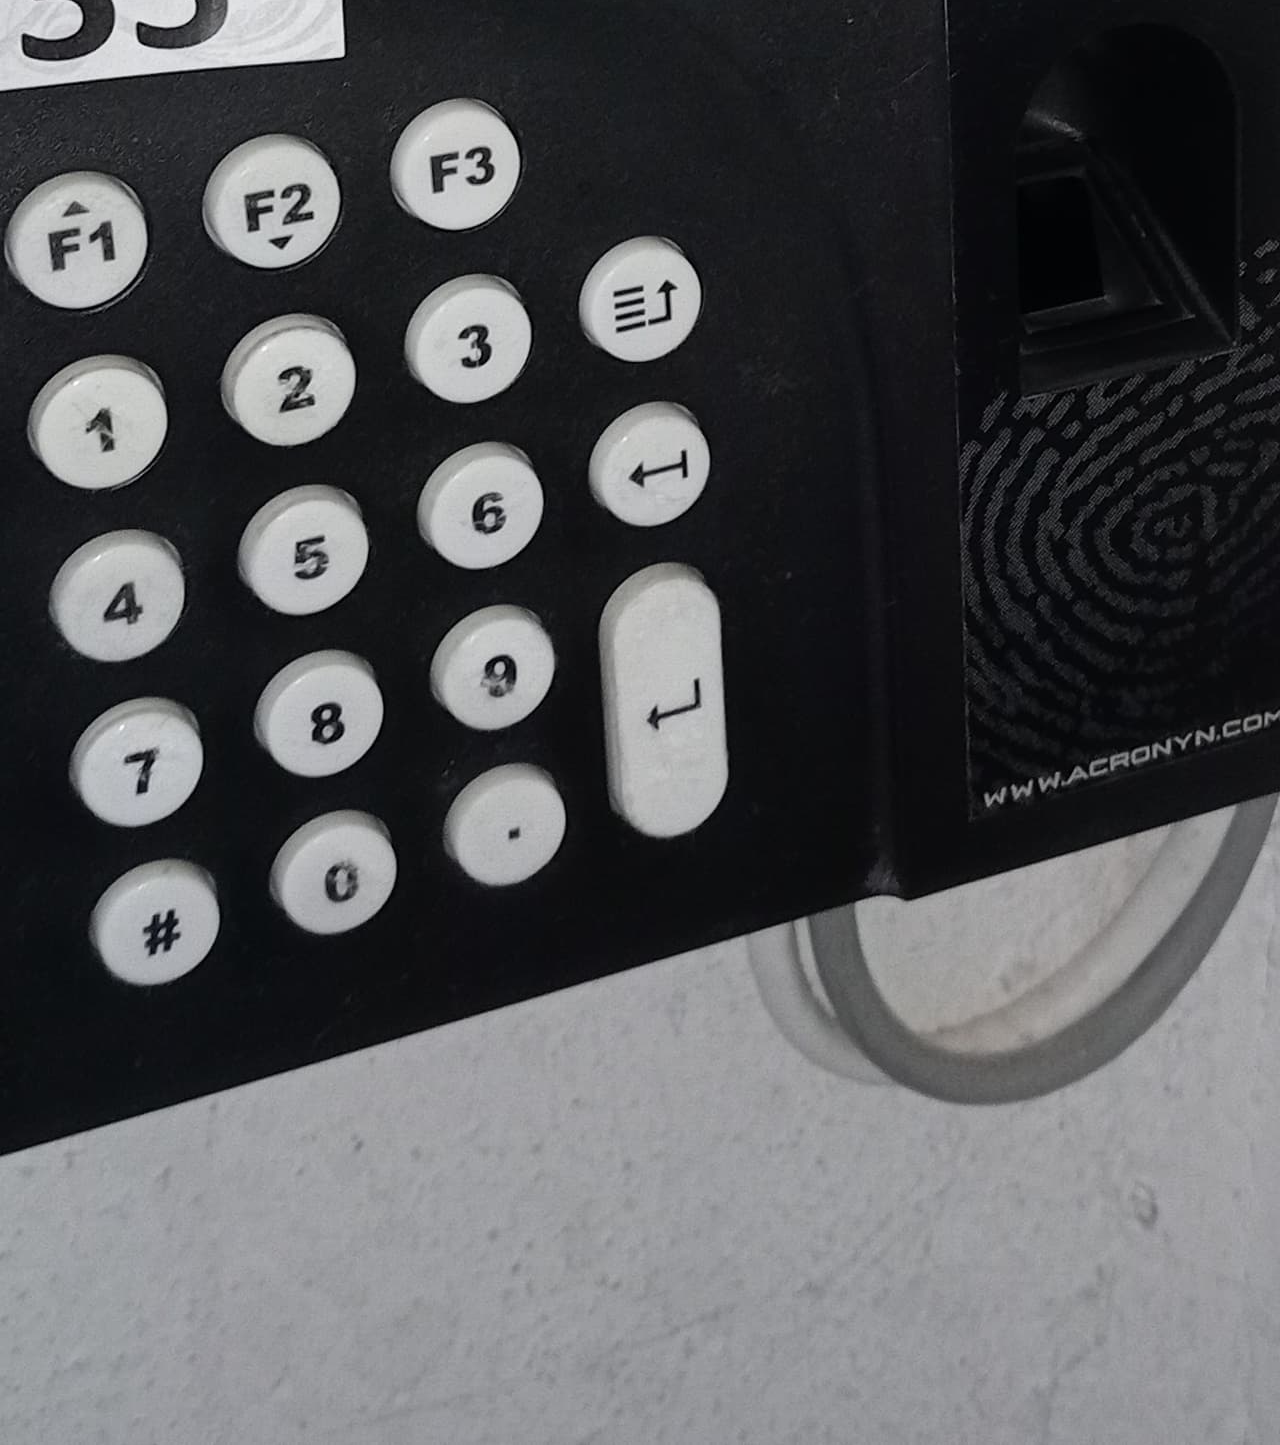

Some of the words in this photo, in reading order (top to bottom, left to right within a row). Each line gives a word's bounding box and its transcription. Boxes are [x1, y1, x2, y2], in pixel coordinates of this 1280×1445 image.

[429, 145, 496, 193] F3
[244, 183, 315, 232] F2
[48, 220, 116, 271] F1
[459, 324, 493, 370] 3
[279, 365, 315, 413] 2
[85, 409, 115, 452] 1
[472, 492, 507, 534] 6
[295, 536, 329, 580] 5
[104, 582, 143, 625] 4
[483, 654, 517, 697] 9
[311, 702, 345, 745] 8
[125, 748, 161, 794] 7
[325, 862, 359, 903] 0
[144, 909, 181, 954] #
